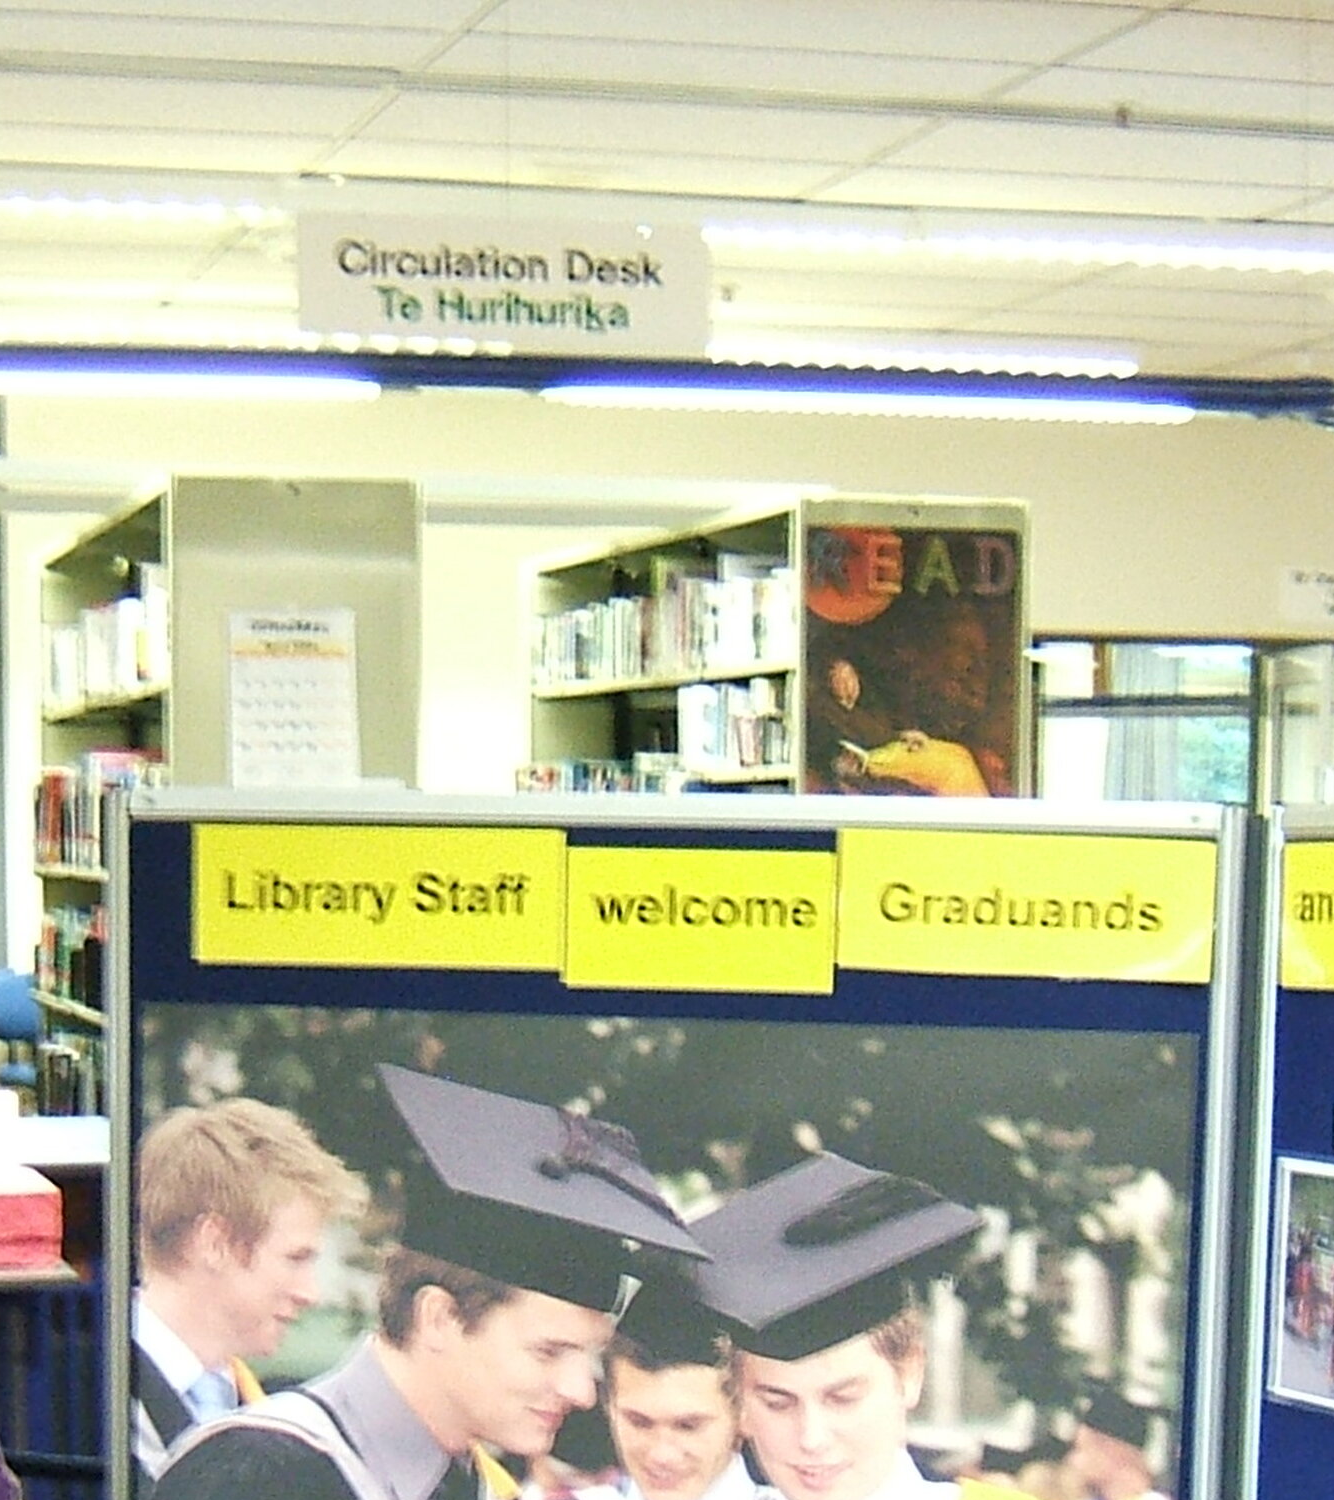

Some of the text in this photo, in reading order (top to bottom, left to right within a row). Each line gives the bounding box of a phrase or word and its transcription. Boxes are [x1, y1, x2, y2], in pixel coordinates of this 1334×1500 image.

[337, 239, 664, 287] Circulation Desk
[375, 285, 422, 322] Te
[810, 532, 1017, 597] READ
[223, 869, 530, 925] Library Staff
[594, 884, 818, 930] welcome
[878, 880, 1164, 934] Graduands
